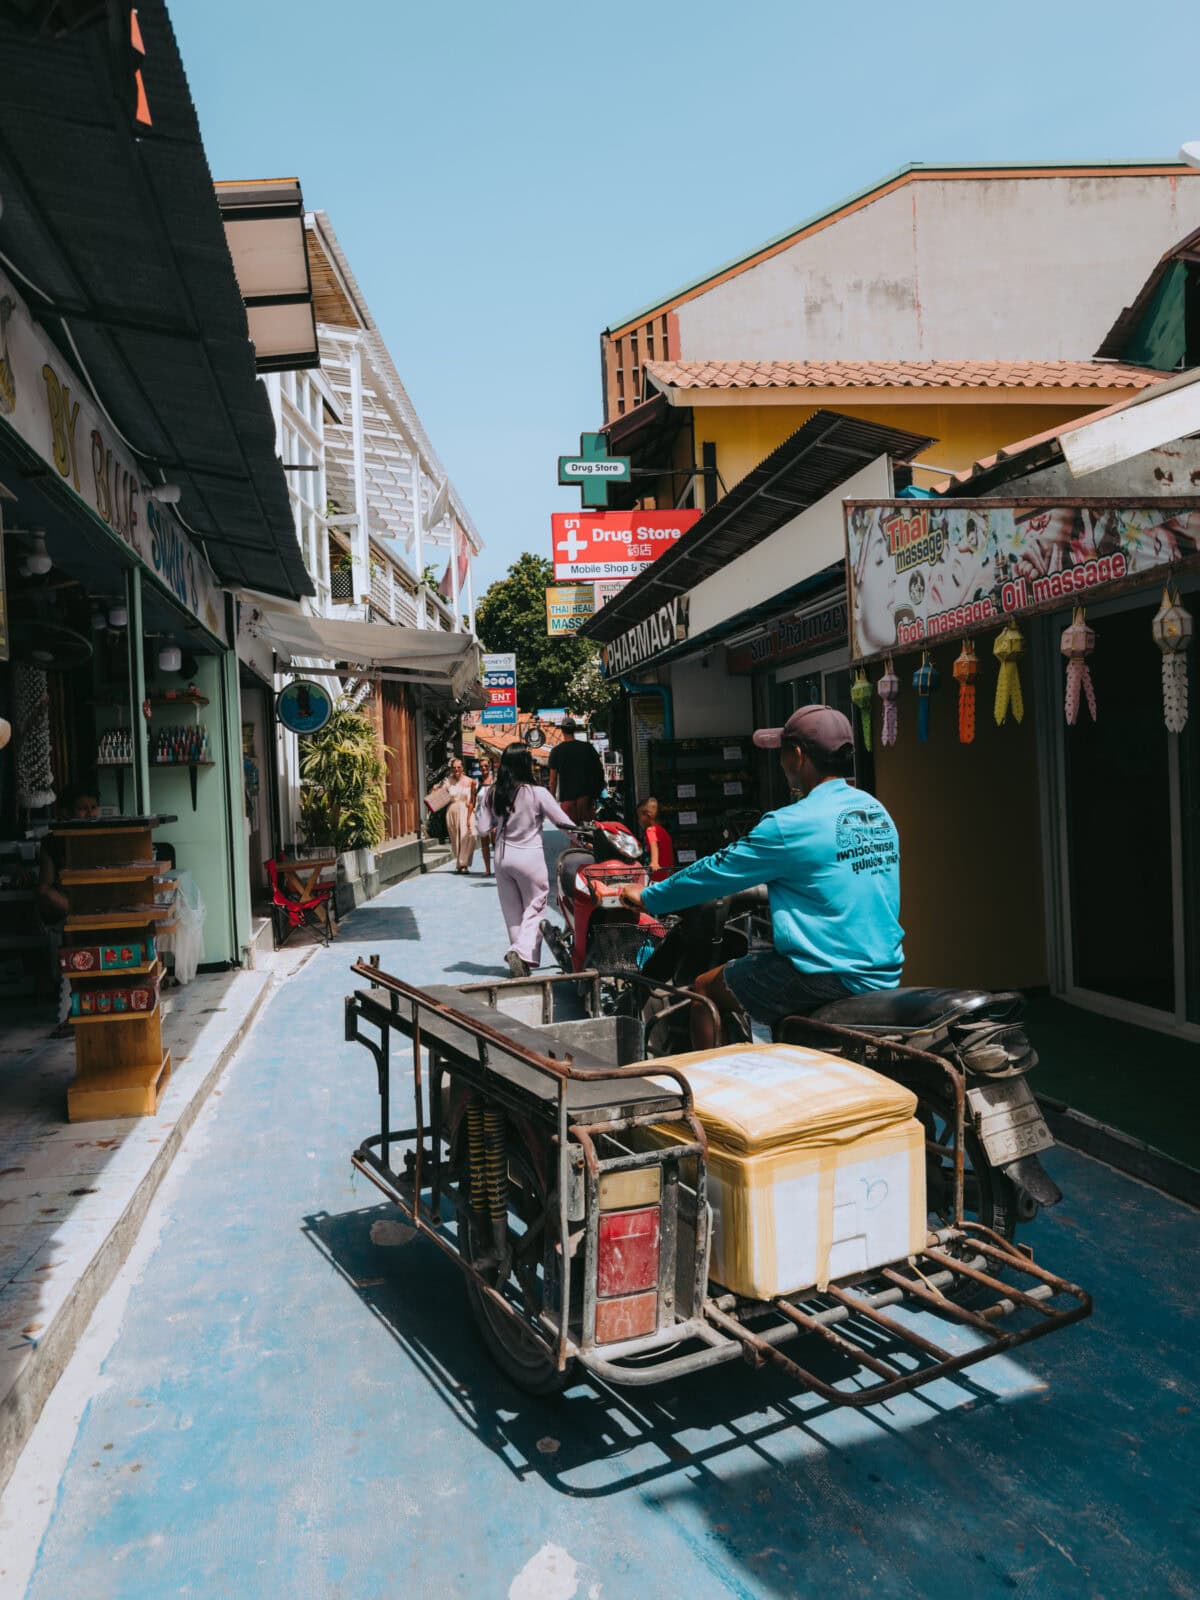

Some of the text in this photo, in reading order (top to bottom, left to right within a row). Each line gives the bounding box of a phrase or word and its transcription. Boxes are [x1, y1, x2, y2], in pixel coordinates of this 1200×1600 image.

[42, 363, 81, 491] BY
[571, 463, 619, 473] Drug Store
[592, 527, 681, 543] Drug Store
[886, 510, 929, 552] Thai
[895, 531, 944, 573] massage
[570, 564, 601, 574] Mobile
[604, 563, 628, 574] Shop
[551, 605, 569, 614] THAI
[897, 618, 924, 645] foot
[1001, 578, 1027, 612] Oil
[1033, 554, 1126, 602] massage
[607, 596, 678, 675] PHARMACY
